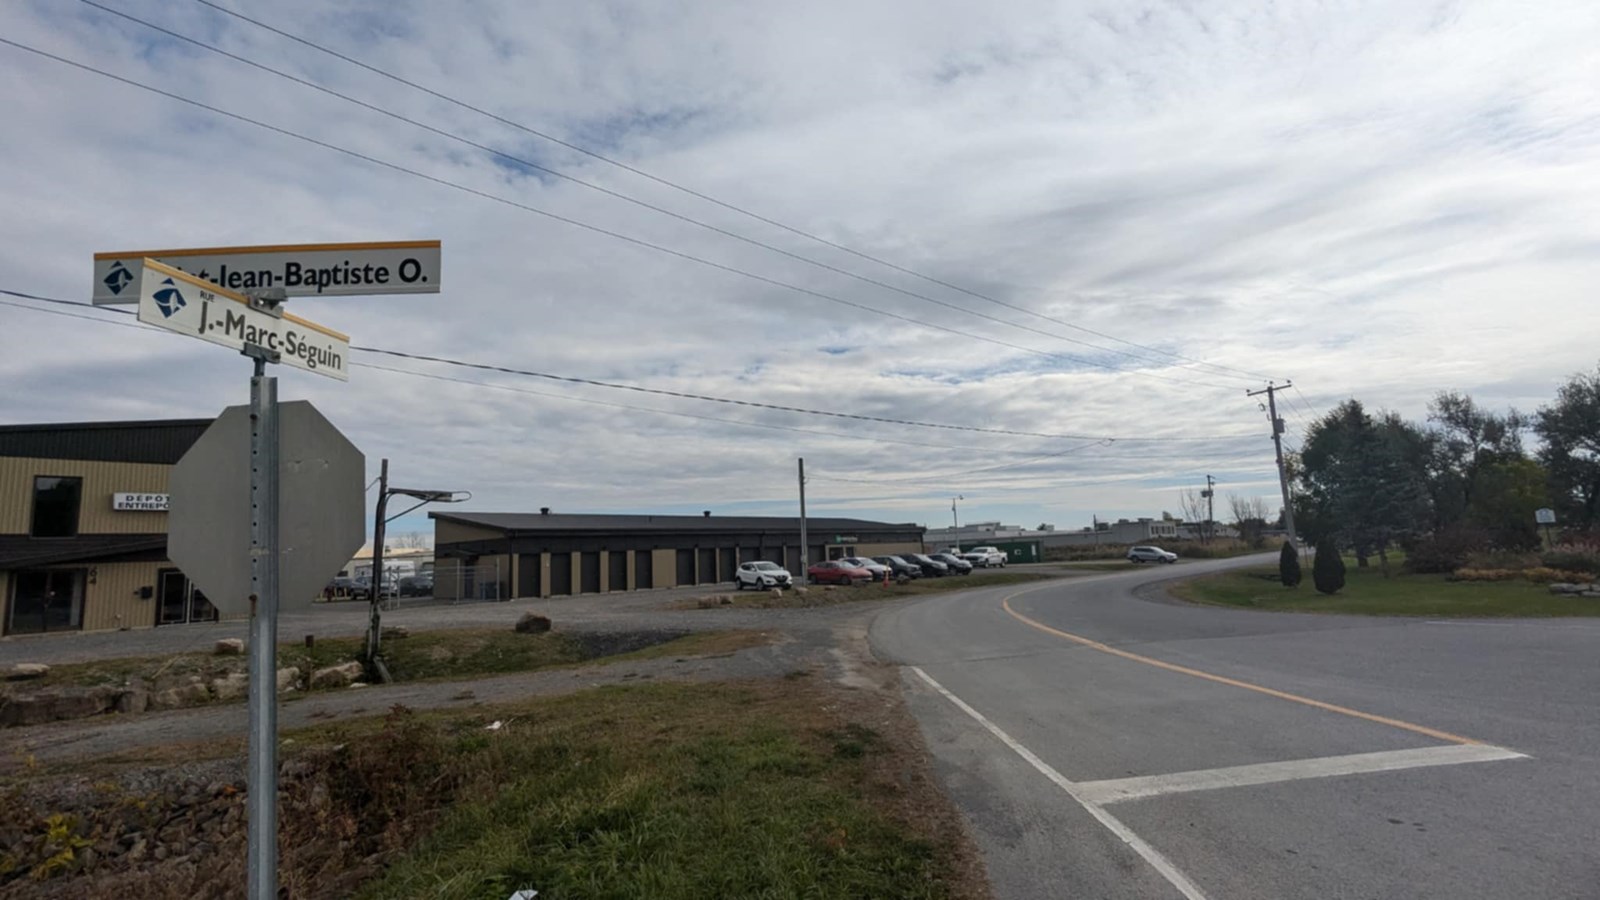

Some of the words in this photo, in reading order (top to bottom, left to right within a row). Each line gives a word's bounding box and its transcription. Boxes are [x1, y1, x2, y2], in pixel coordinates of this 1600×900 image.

[175, 260, 390, 294] t-Jean-Baptiste
[398, 258, 428, 283] O.
[200, 289, 214, 303] RUE
[198, 301, 341, 370] J.-Marc-Séguin
